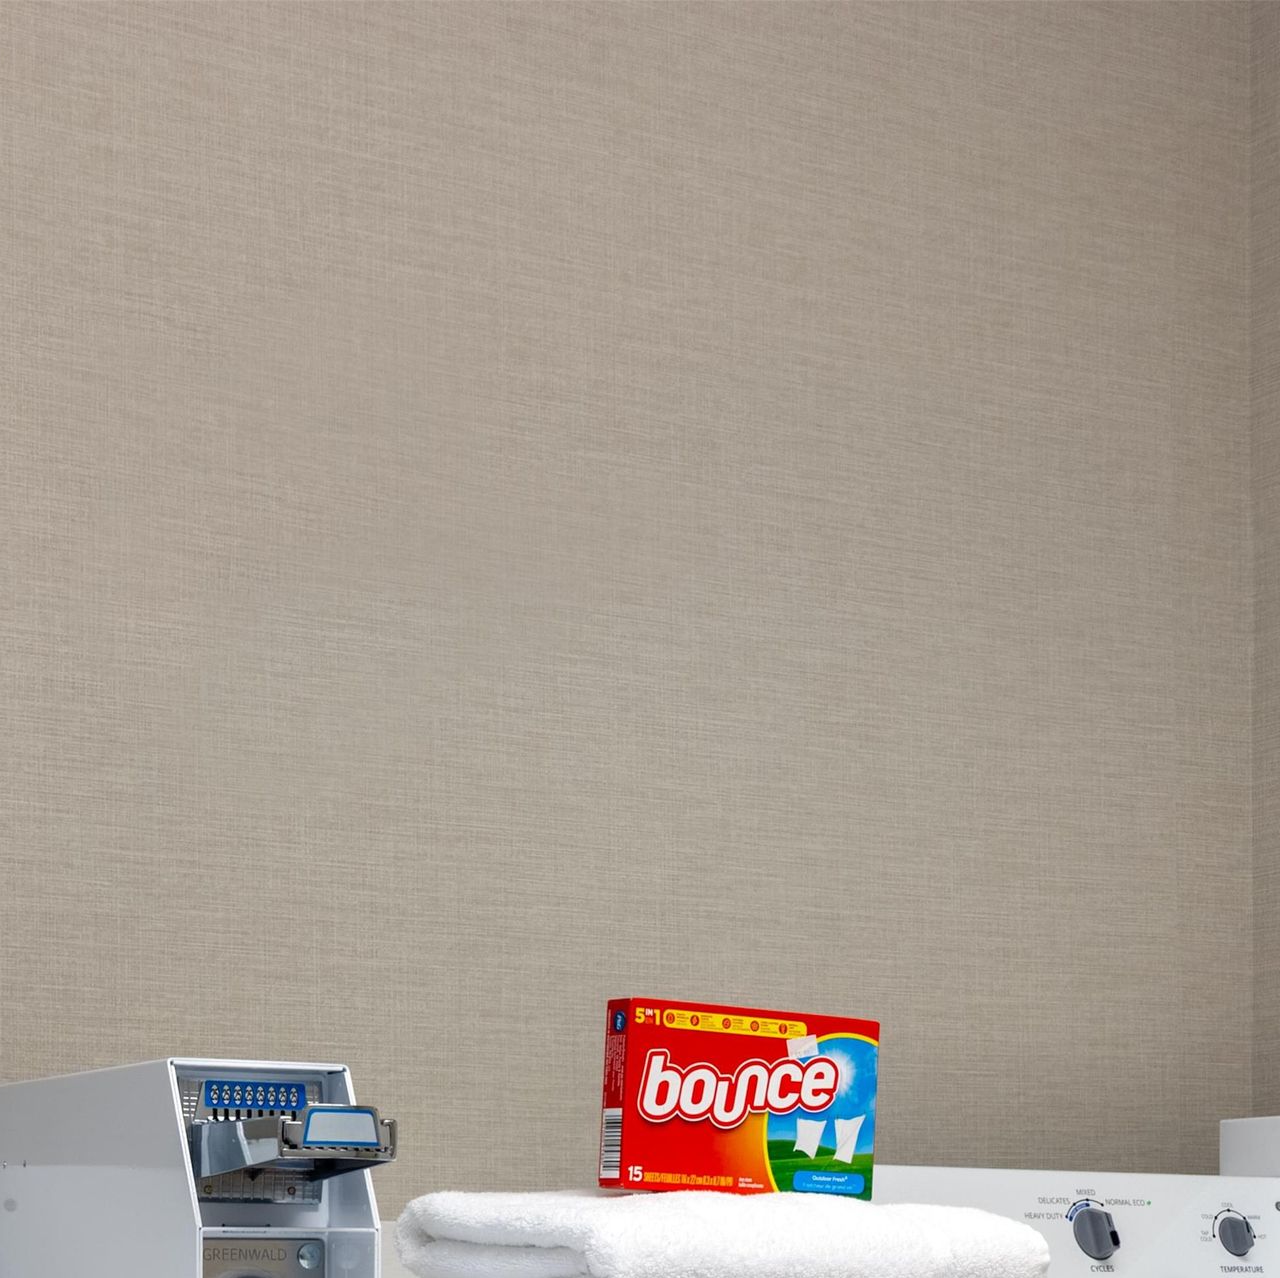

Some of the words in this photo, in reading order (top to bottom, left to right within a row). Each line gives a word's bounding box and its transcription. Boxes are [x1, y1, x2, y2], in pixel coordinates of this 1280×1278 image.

[635, 1007, 645, 1024] 5
[653, 1008, 660, 1026] 1
[640, 1053, 837, 1124] bounce
[628, 1165, 643, 1182] 15
[1038, 1197, 1070, 1205] DELICATES
[1024, 1212, 1045, 1220] HEAVY
[1046, 1212, 1063, 1220] DUTY
[203, 1247, 287, 1261] GREENWALD
[1090, 1265, 1115, 1273] CYCLES
[1220, 1265, 1264, 1274] TEMPERATURE
